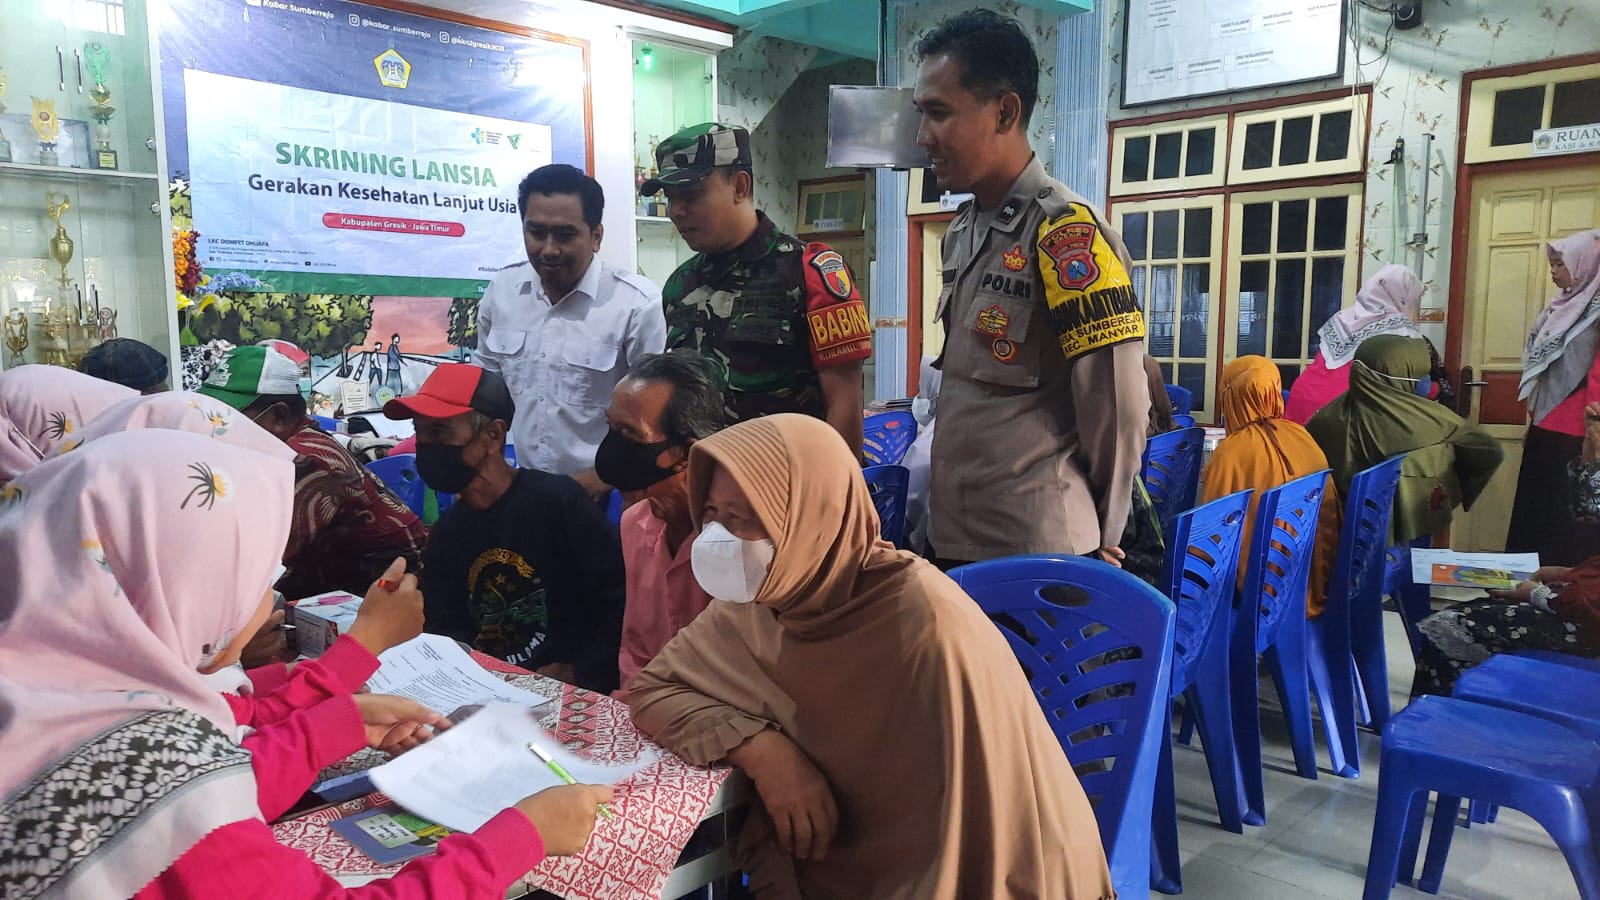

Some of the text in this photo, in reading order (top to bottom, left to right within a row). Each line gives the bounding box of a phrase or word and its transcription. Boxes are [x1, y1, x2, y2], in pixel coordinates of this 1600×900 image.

[263, 0, 335, 19] Kabar Sumberrejo
[275, 142, 497, 188] SKRINING LANSIA
[248, 174, 517, 214] Gerakan Kesehatan Lanjut Usia
[340, 217, 382, 228] Kabupaten
[383, 220, 407, 230] Gresik
[412, 223, 429, 231] Jawa
[430, 224, 450, 233] Timur
[982, 273, 1031, 298] POLRI
[1076, 313, 1141, 338] SUMBEREJO
[1087, 325, 1139, 346] MANYAR
[506, 631, 546, 665] ULAMA
